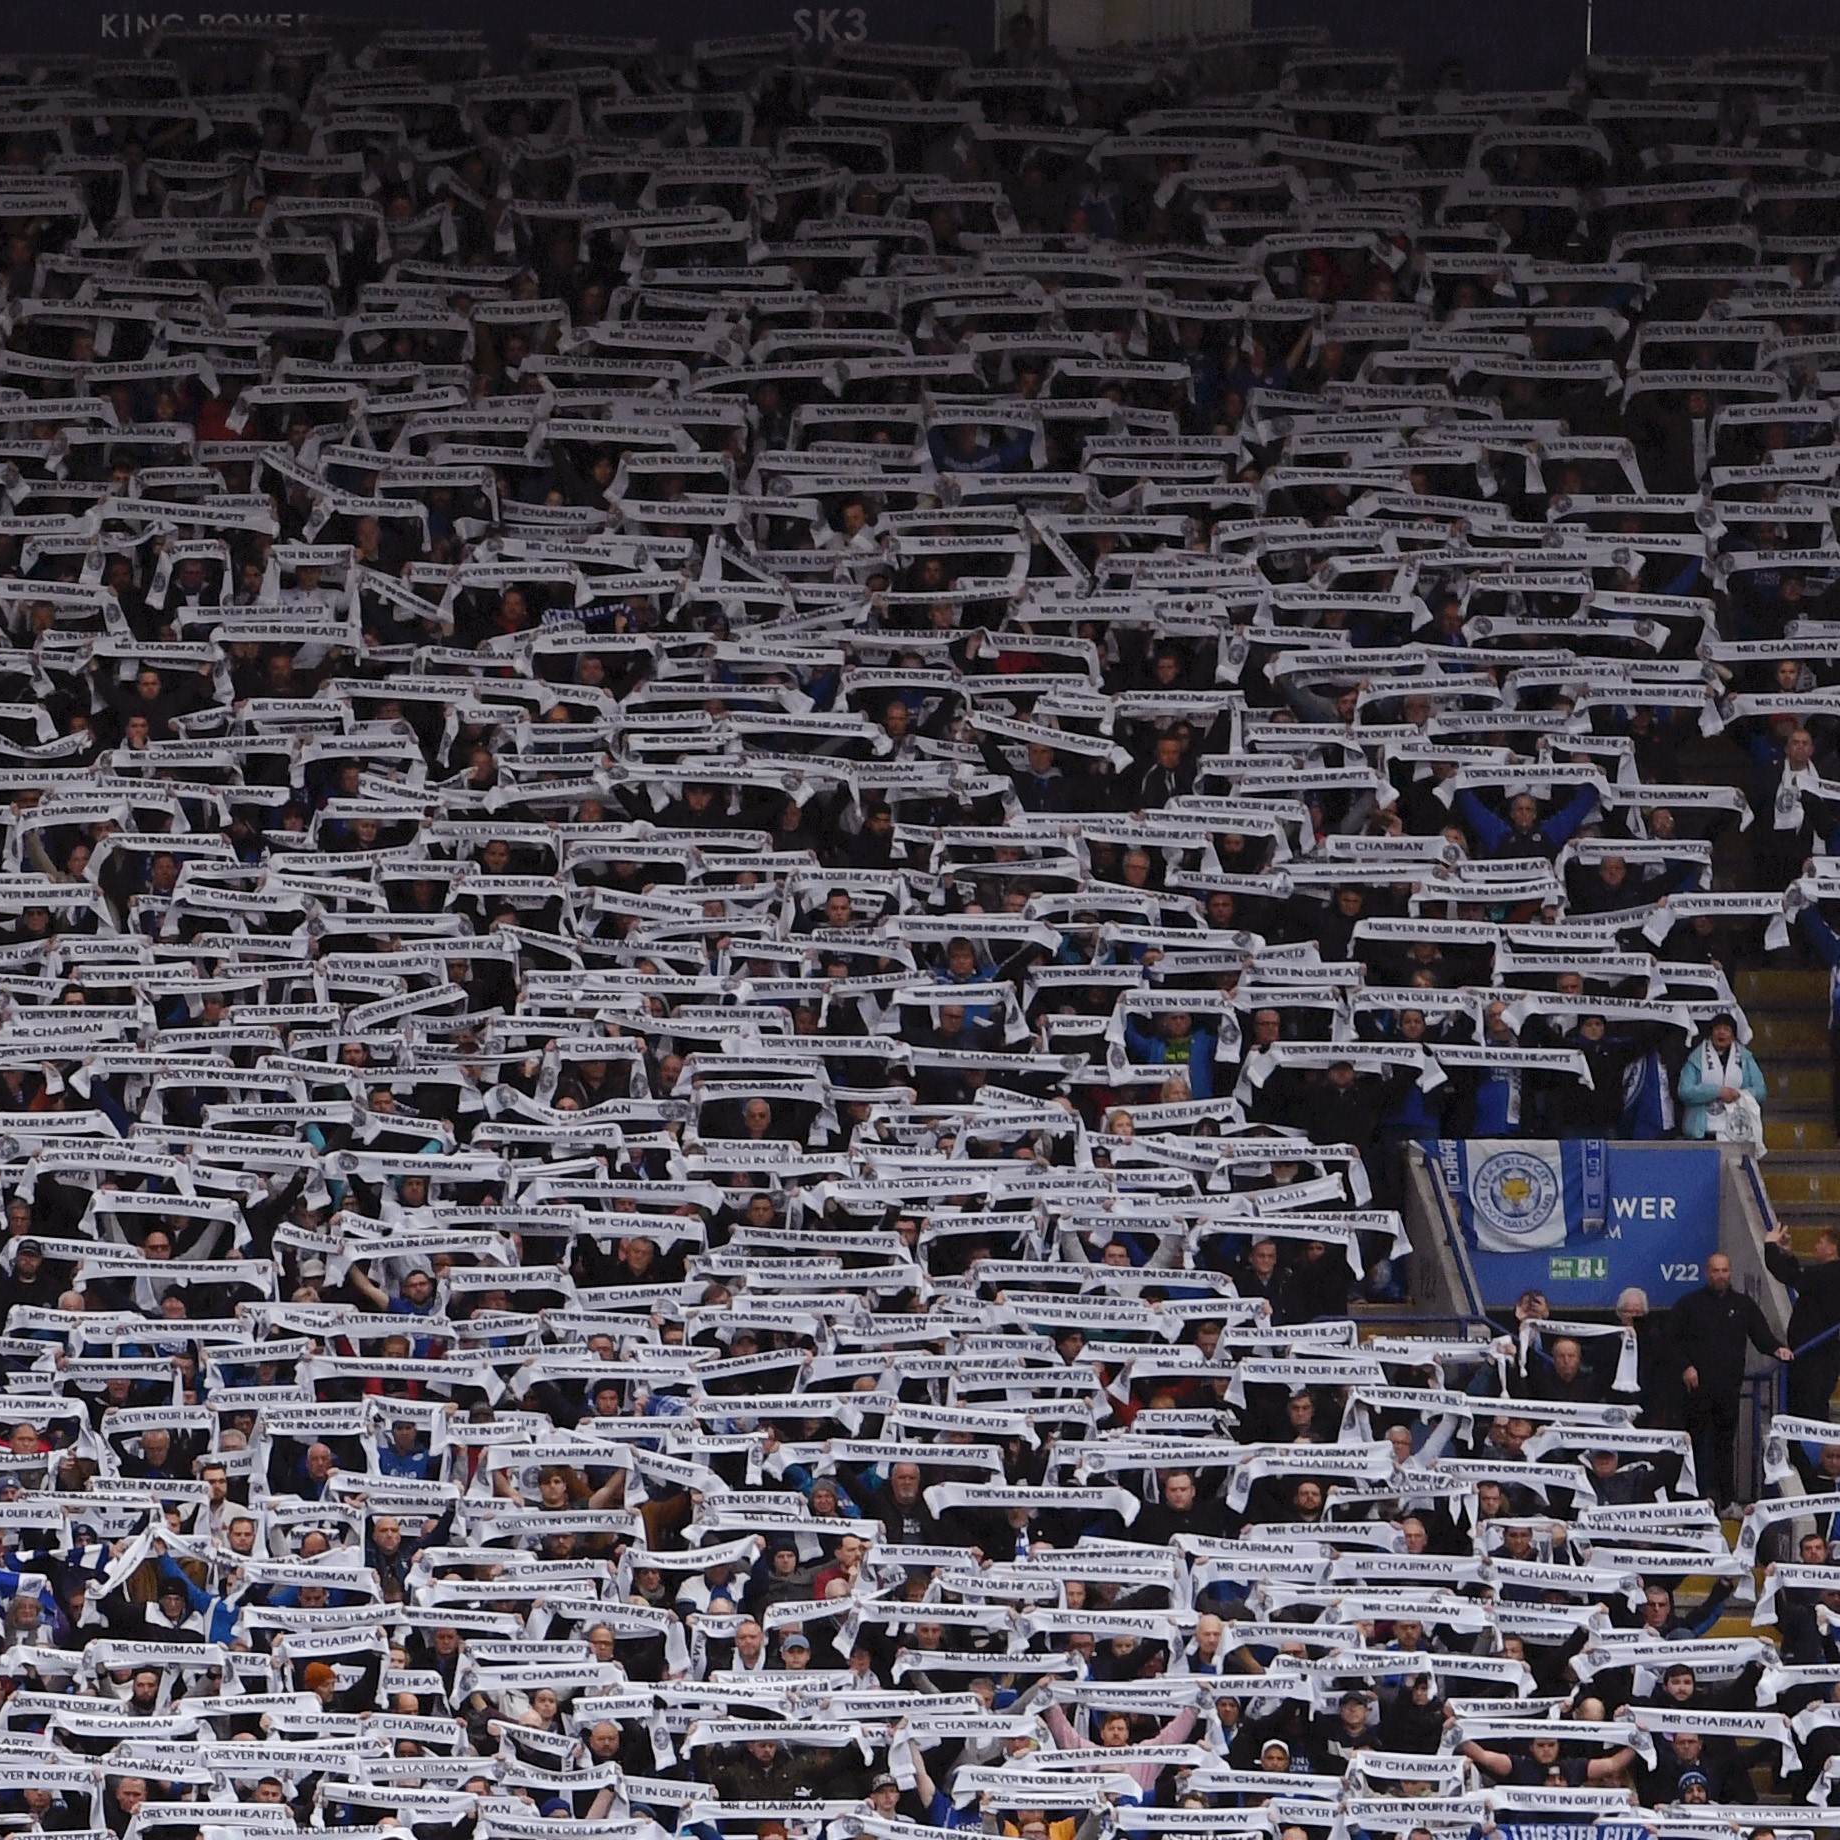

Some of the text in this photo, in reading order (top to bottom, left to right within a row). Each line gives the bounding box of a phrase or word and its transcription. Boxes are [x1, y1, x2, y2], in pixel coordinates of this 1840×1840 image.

[793, 8, 868, 42] SK3
[23, 805, 110, 820] MR CHAIRMAN
[190, 889, 277, 903] MR CHAIRMAN
[1480, 1157, 1531, 1189] LEICESTER
[1613, 1198, 1675, 1219] WER
[1661, 1264, 1699, 1281] V22
[699, 1314, 793, 1323] MR CHAIRMAN
[846, 1445, 989, 1459] FOREVER IN OUR HEARTS
[347, 1790, 448, 1804] MR CHAIRMAN
[746, 1801, 825, 1811] CHAIRMAN
[1147, 1813, 1248, 1823] MR CHAIRMAN
